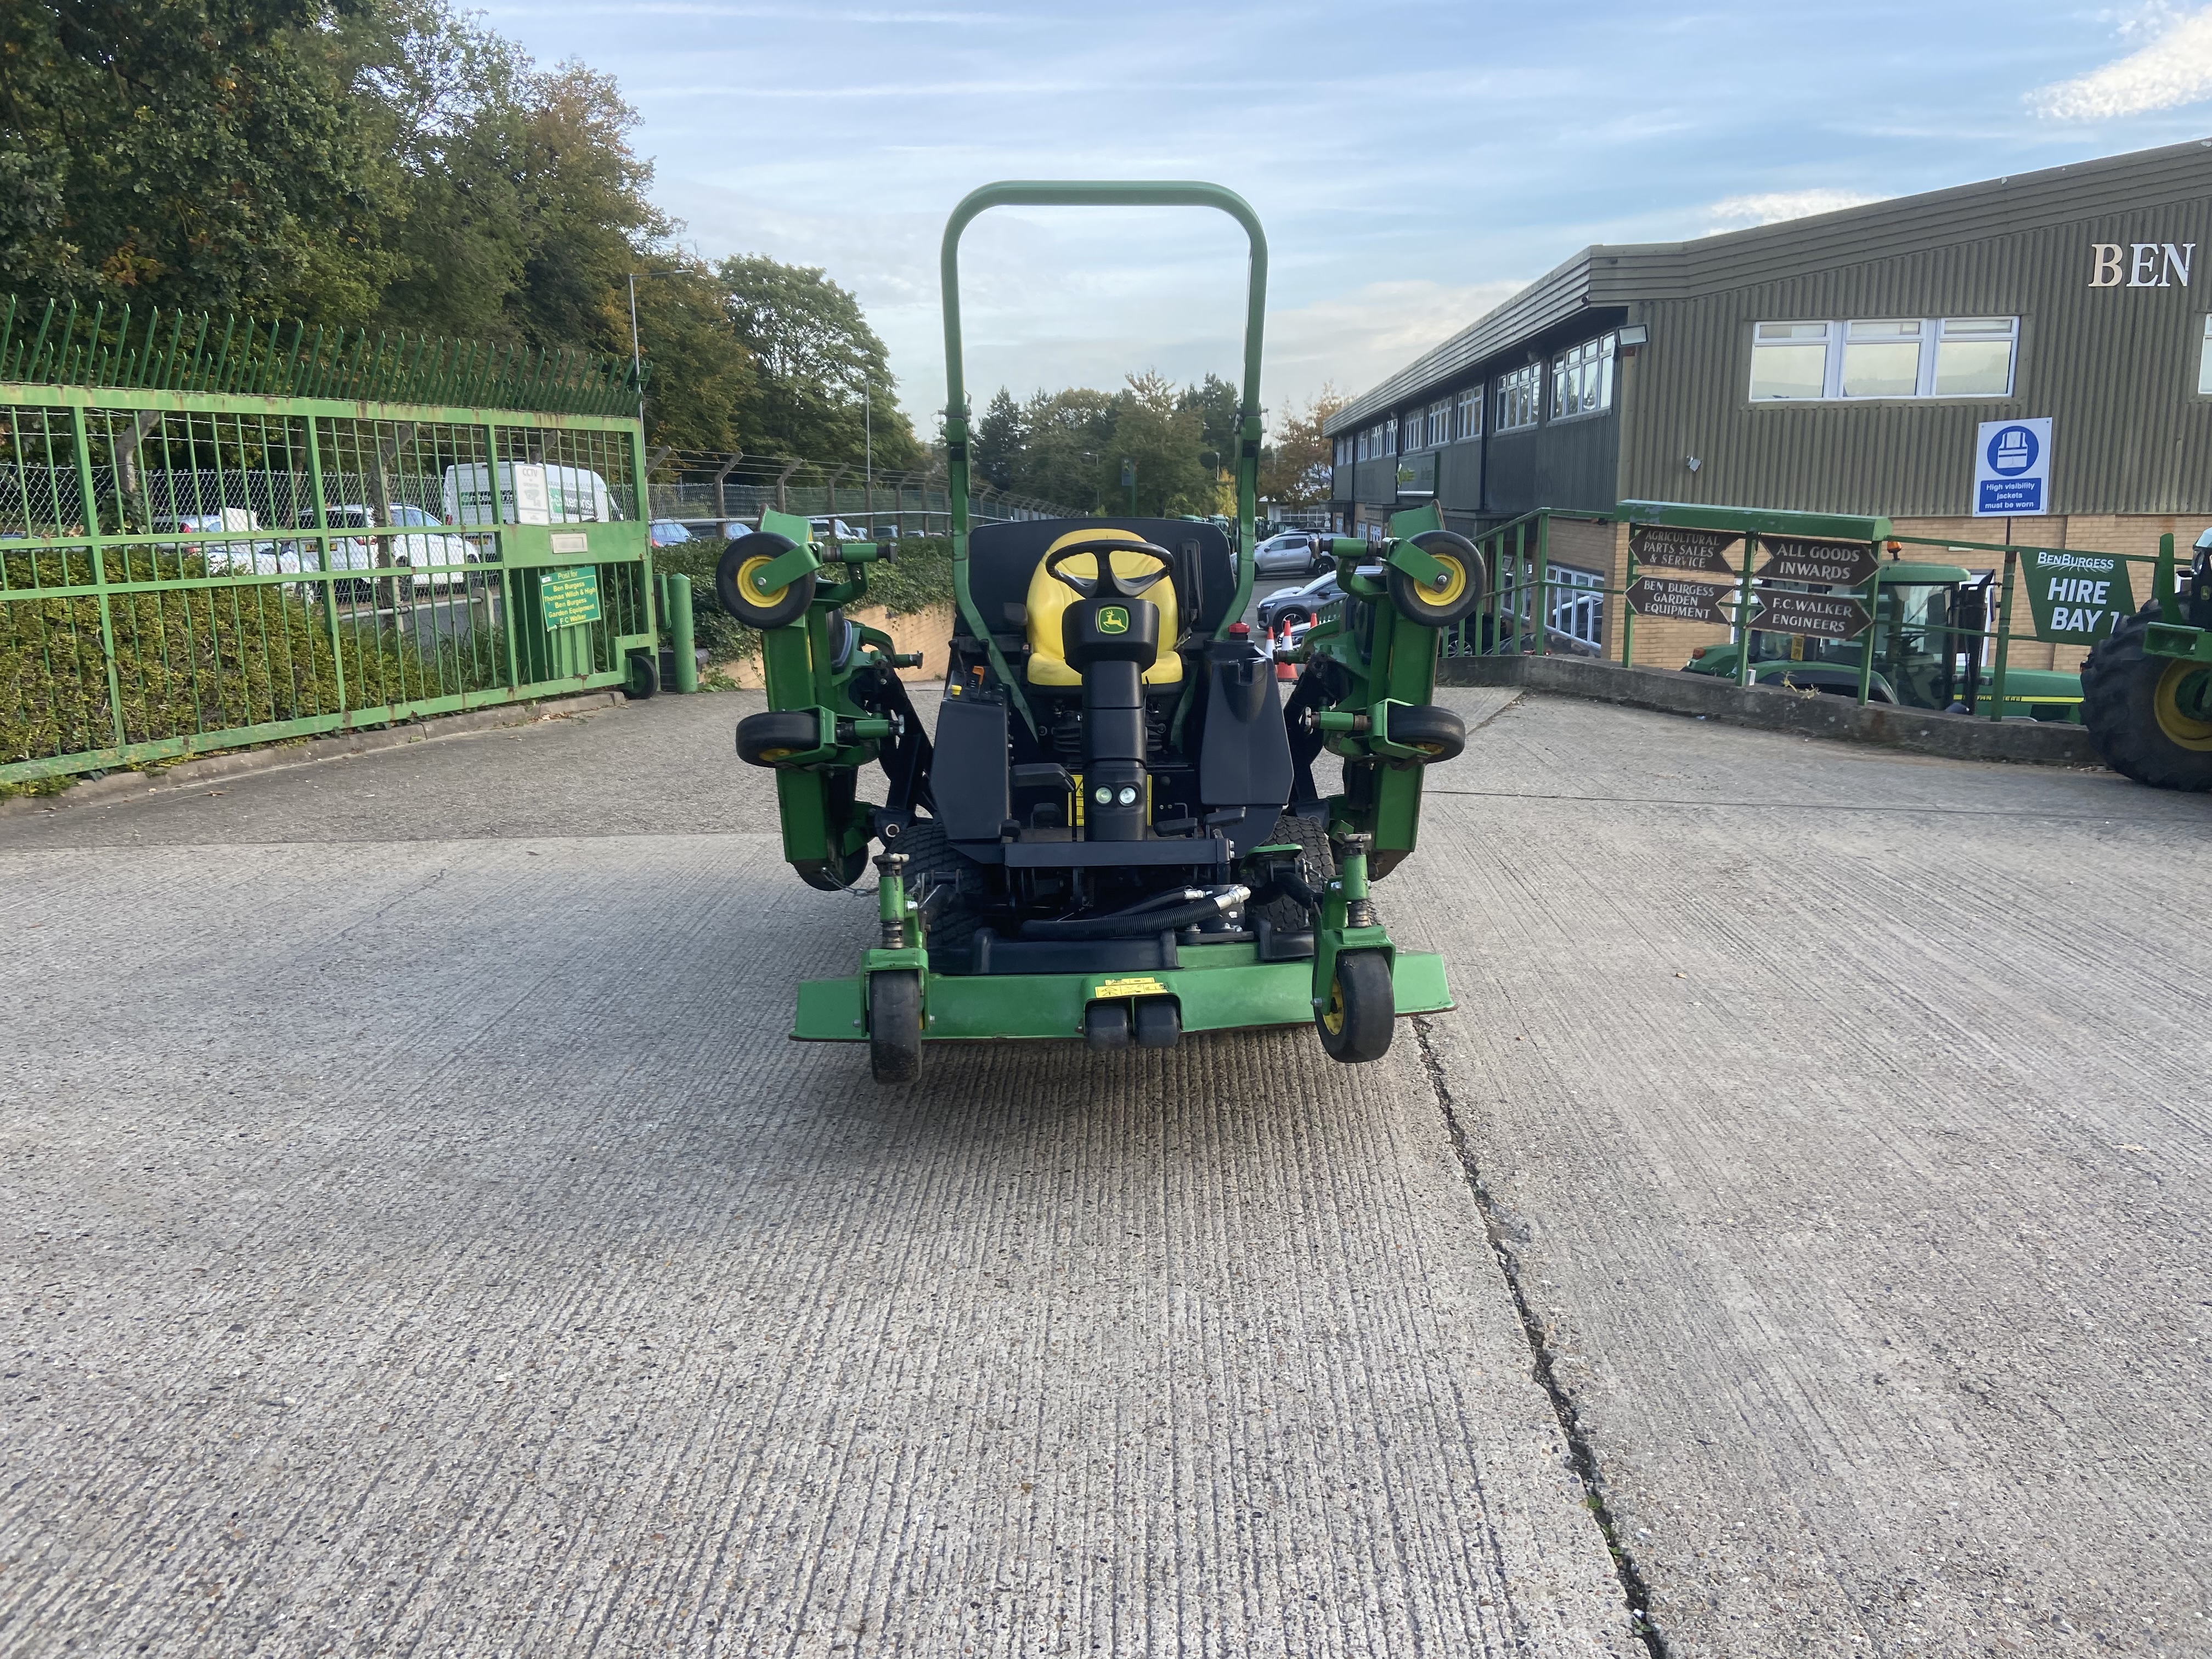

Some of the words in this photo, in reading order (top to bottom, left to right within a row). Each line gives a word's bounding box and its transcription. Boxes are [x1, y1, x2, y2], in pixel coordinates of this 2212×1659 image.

[2088, 243, 2196, 287] BEN
[523, 468, 538, 477] CCTV
[1986, 483, 2003, 492] High
[2005, 482, 2035, 490] visibility
[1996, 492, 2023, 501] jackets
[1645, 531, 1720, 546] AGRICULTURAL
[1679, 545, 1714, 558] SALES
[1776, 544, 1805, 558] ALL
[1809, 546, 1860, 562] GOODS
[1650, 554, 1657, 563] &
[1661, 555, 1706, 568] SERVICE
[1779, 561, 1850, 580] INWARDS
[564, 582, 585, 590] Burgess
[1644, 580, 1663, 591] BEN
[1668, 583, 1714, 597] BURGESS
[2047, 577, 2111, 605] HIRE
[544, 594, 565, 602] Thomas
[566, 597, 587, 606] Burgess
[1654, 592, 1698, 606] GARDEN
[548, 609, 568, 618] Garden
[568, 603, 595, 614] Equipment
[1644, 602, 1711, 619] EQUIPMENT
[569, 614, 586, 622] Walker
[1772, 613, 1846, 633] ENGINEERS
[2051, 607, 2103, 633] BAY
